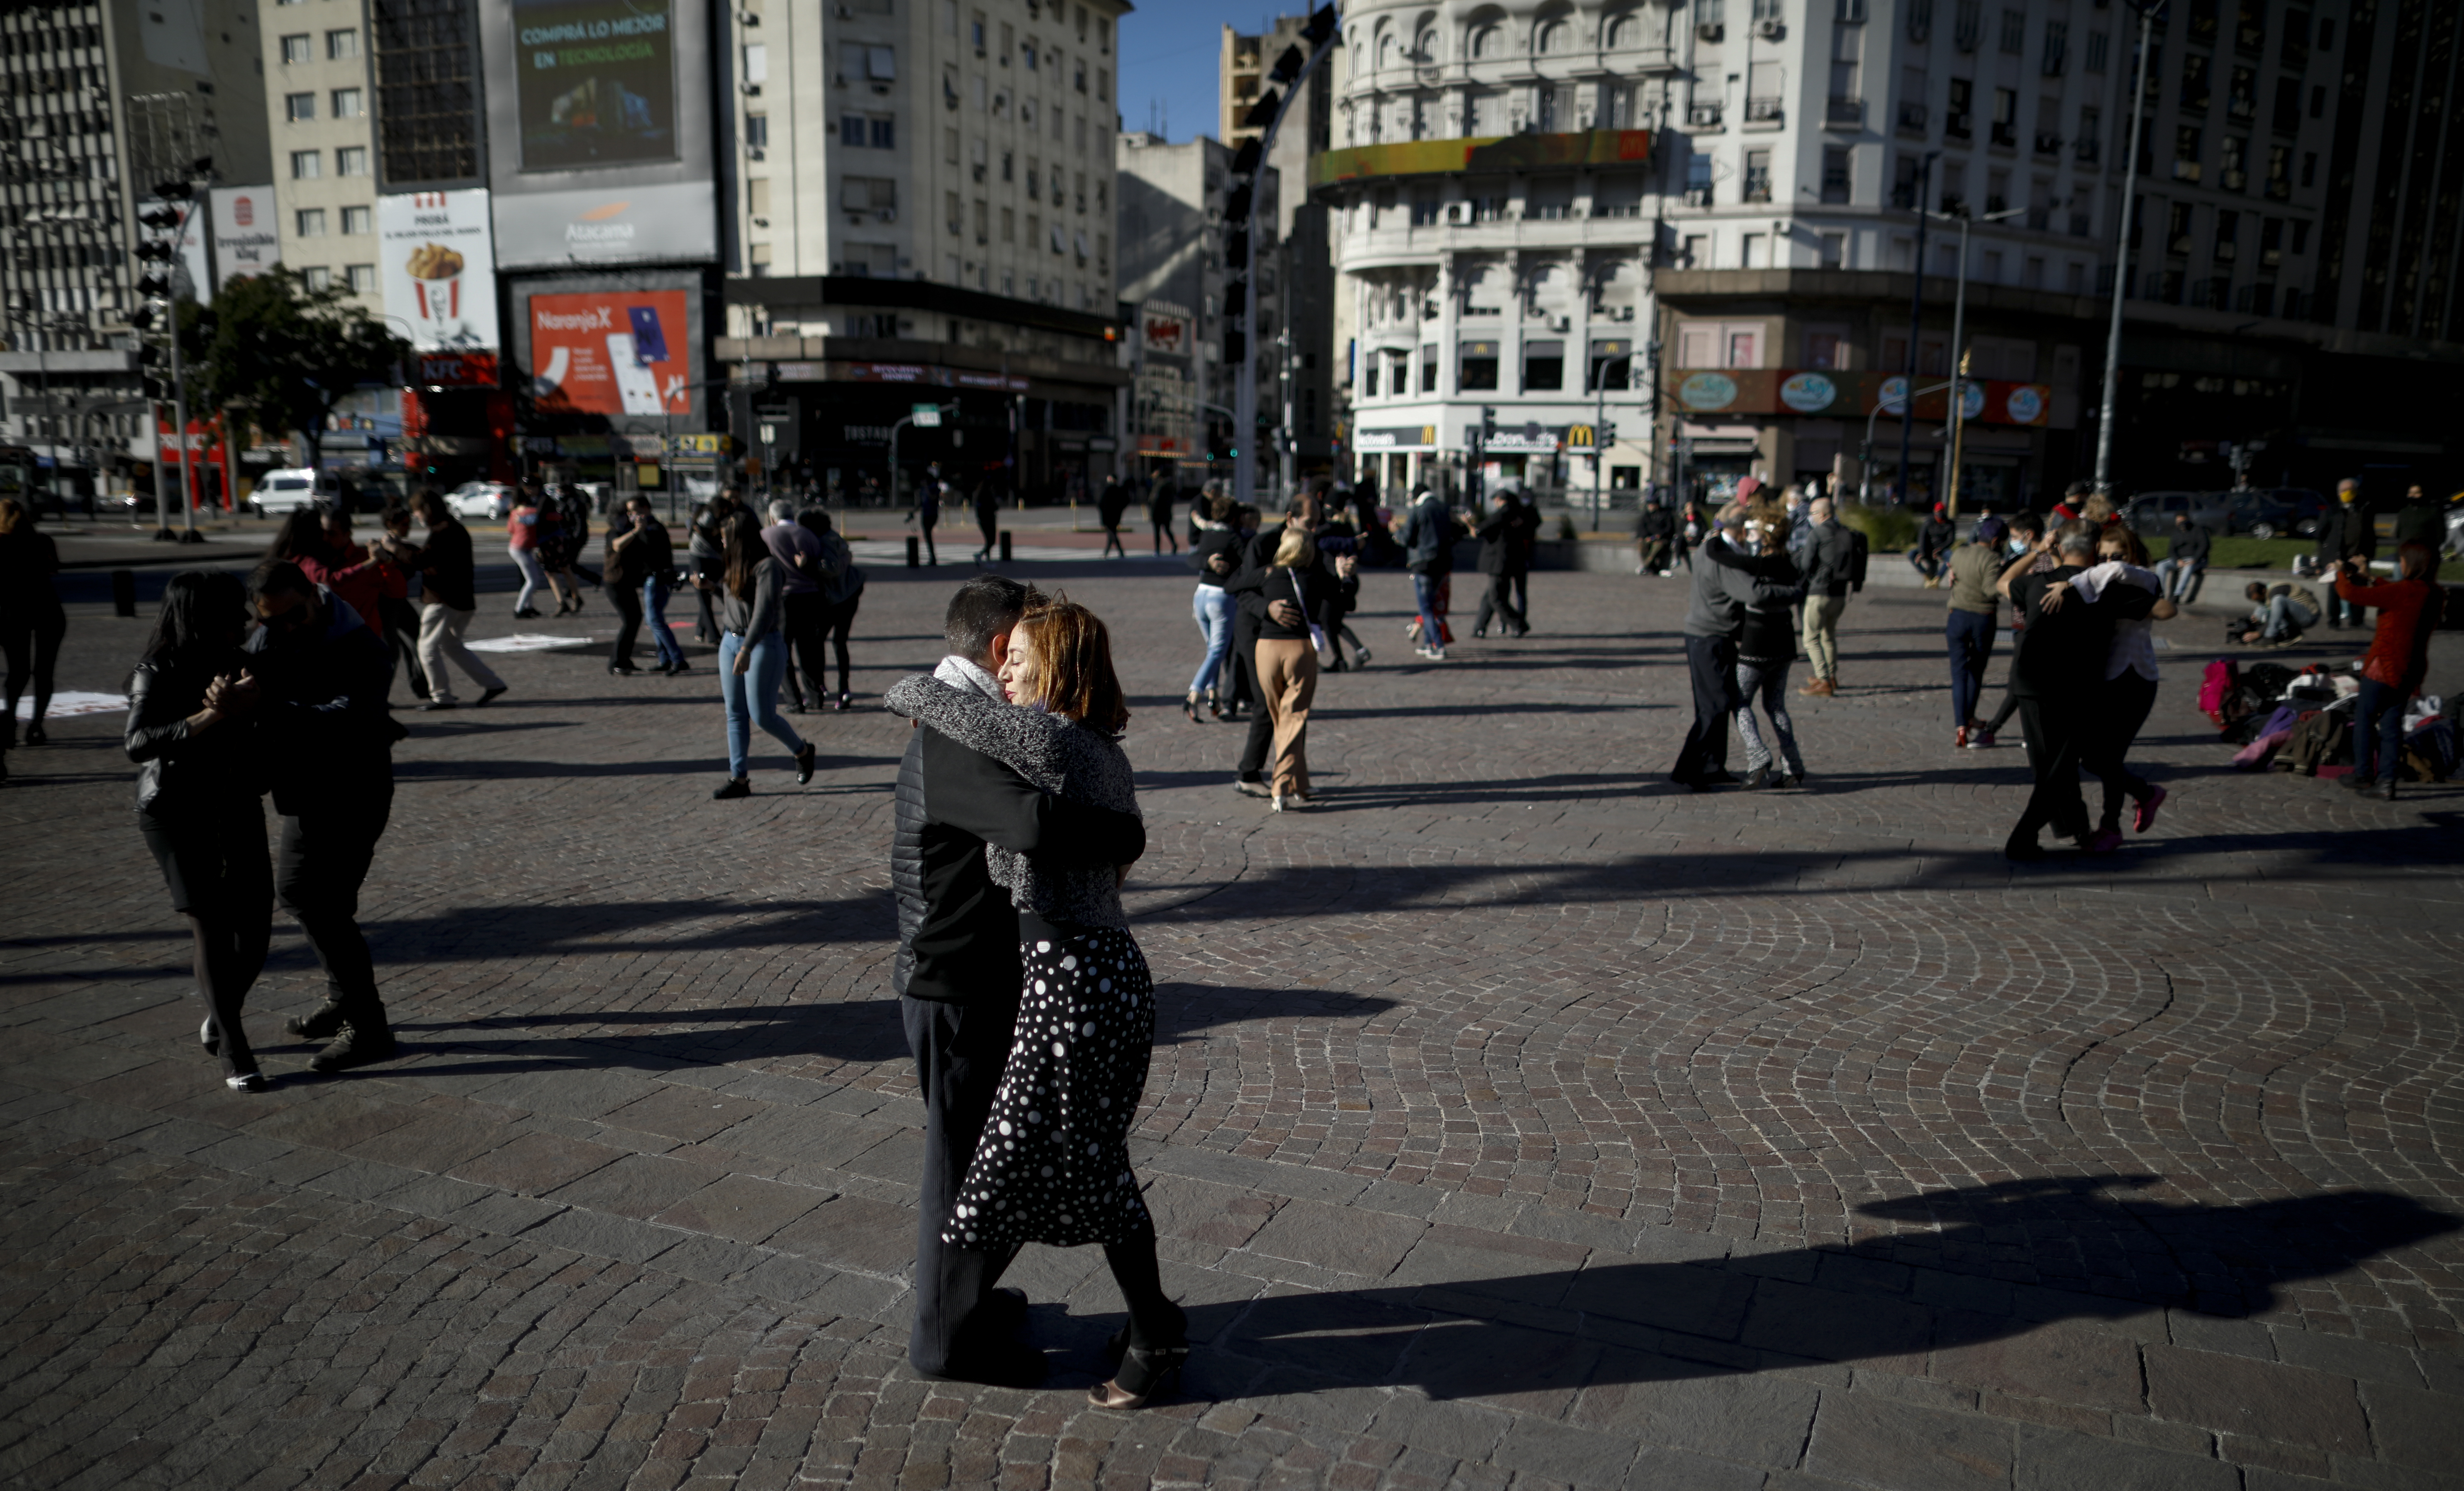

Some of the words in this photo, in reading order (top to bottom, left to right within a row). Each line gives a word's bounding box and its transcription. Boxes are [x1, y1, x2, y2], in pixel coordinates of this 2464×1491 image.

[521, 20, 587, 46] COMPRÁ
[588, 20, 610, 39] LO
[612, 14, 665, 36] MEJOR
[533, 50, 556, 70] EN
[559, 40, 654, 65] TECNOLOGÍA
[565, 223, 634, 241] Atacama
[422, 359, 464, 380] KFC
